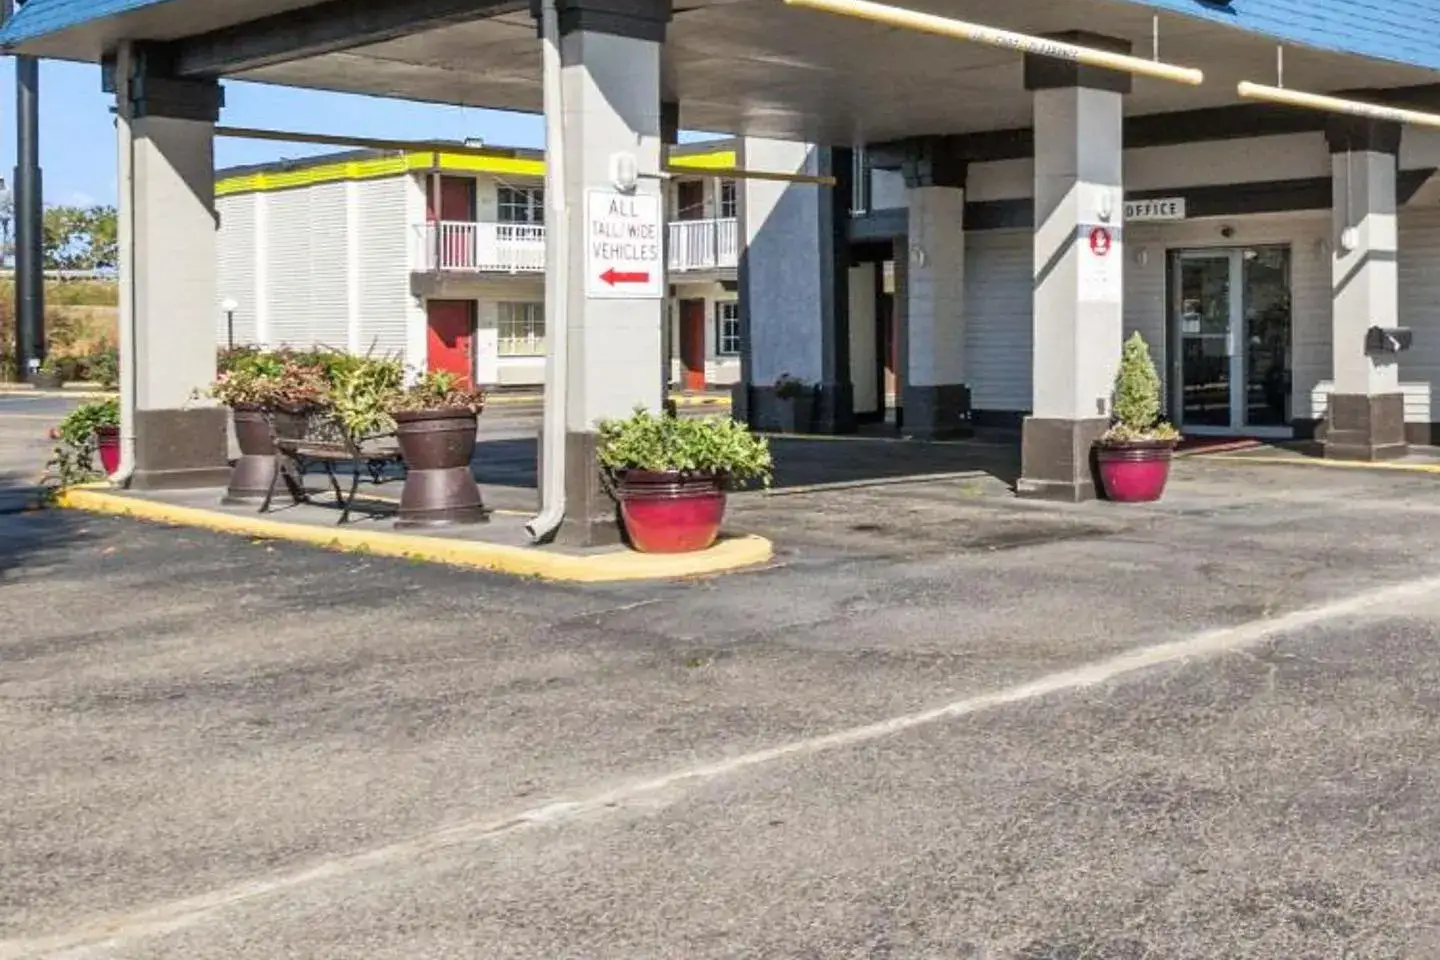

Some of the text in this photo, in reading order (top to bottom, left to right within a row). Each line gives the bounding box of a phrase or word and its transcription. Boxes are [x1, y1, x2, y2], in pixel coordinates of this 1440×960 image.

[609, 198, 639, 217] ALL
[1125, 202, 1177, 218] OFFICE
[592, 241, 658, 261] VEHICLES
